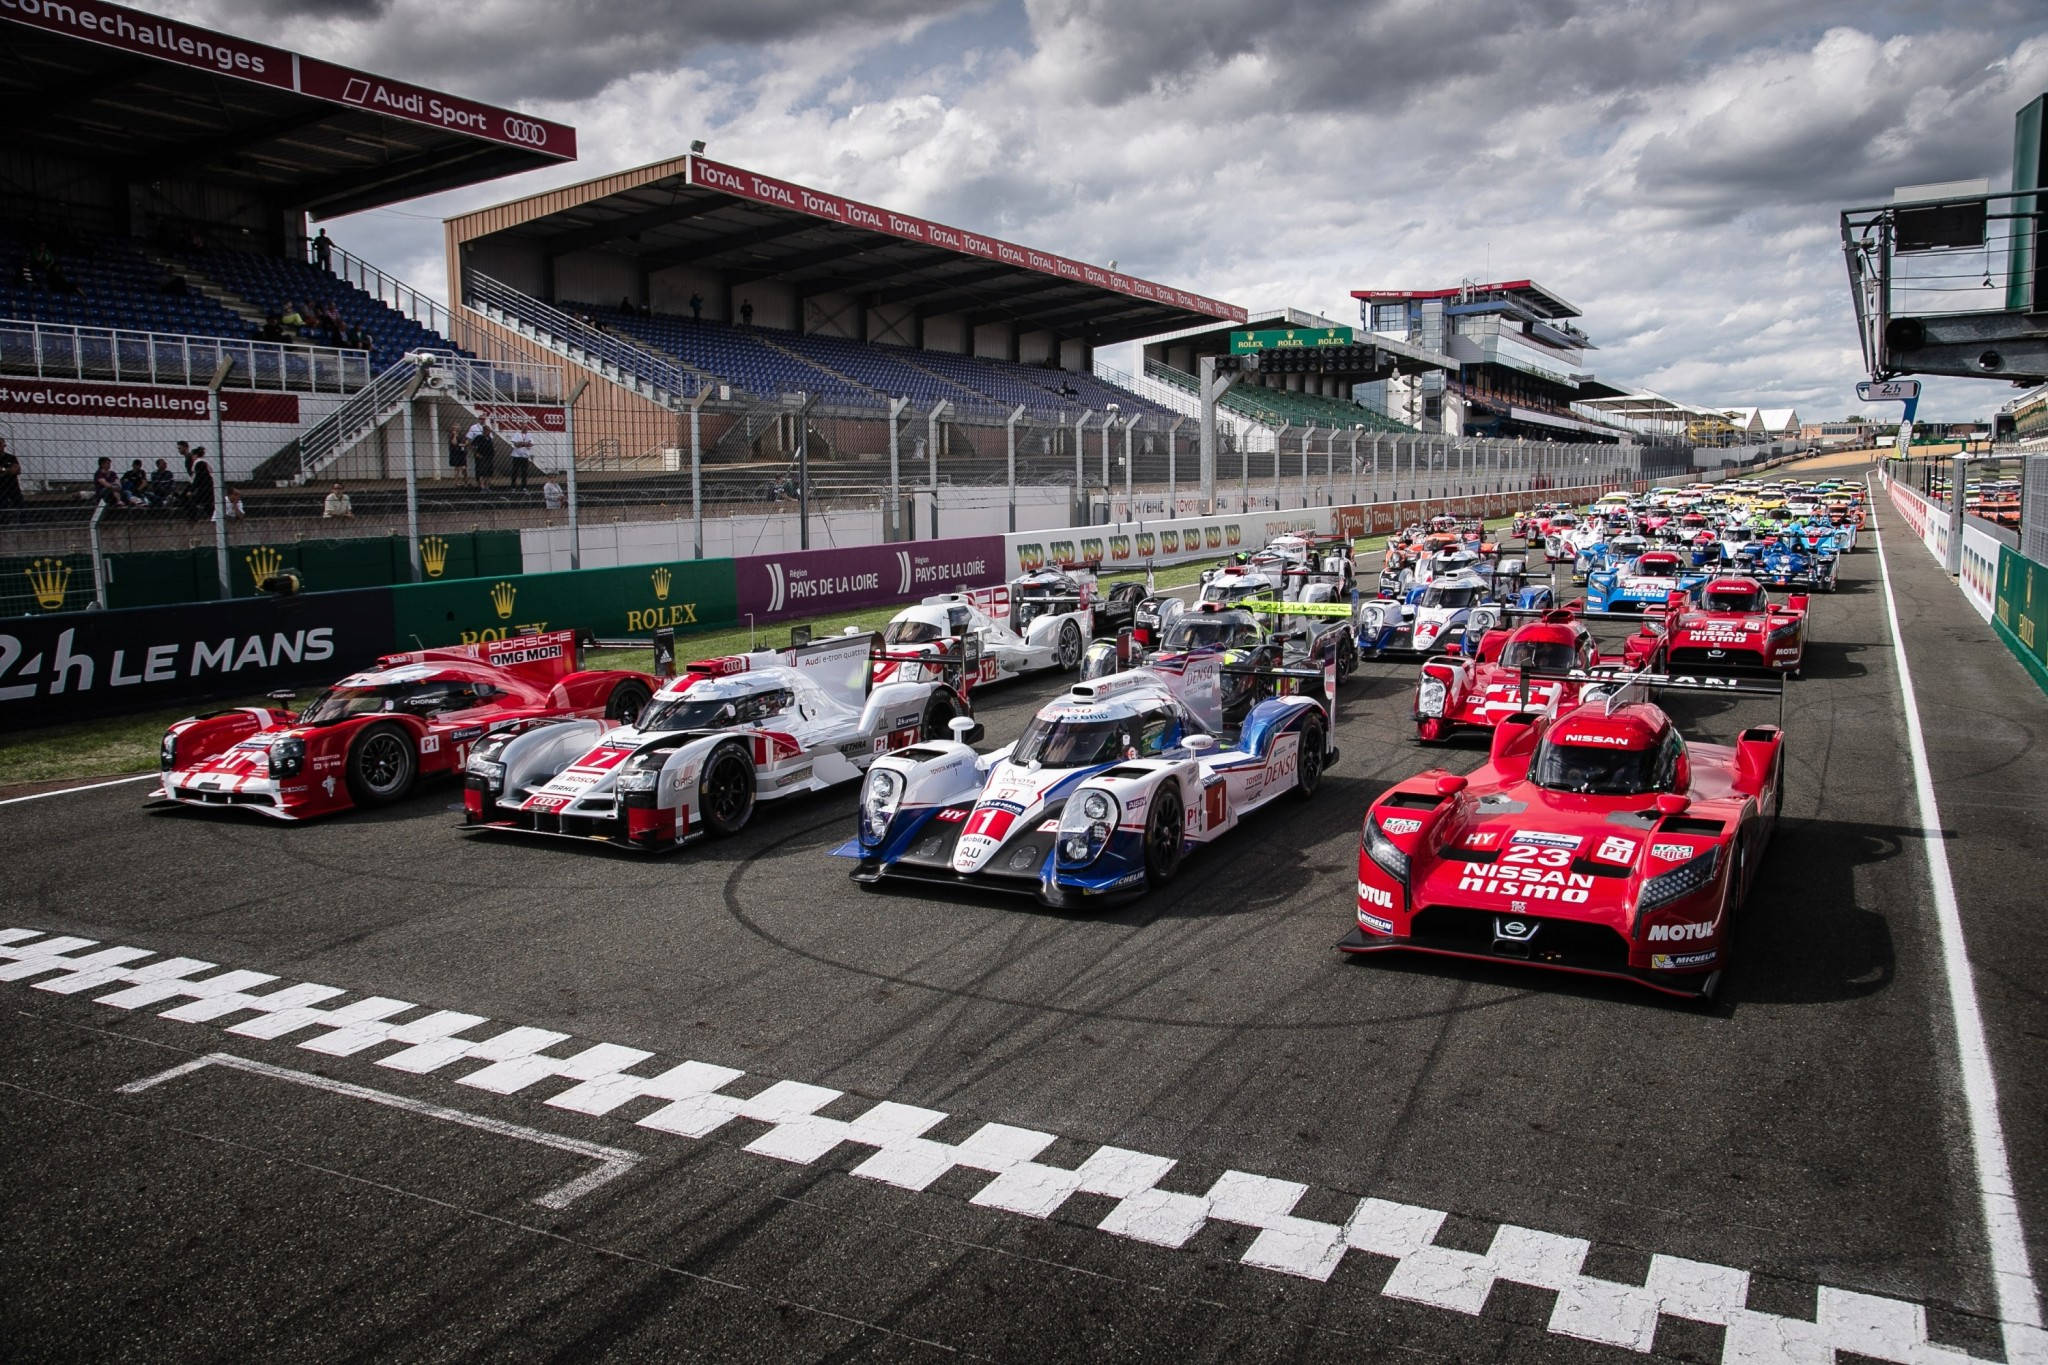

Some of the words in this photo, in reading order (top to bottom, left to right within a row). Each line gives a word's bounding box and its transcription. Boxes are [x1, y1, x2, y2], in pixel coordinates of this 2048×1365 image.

[373, 85, 424, 115] Audi
[430, 99, 487, 130] Sport
[697, 162, 745, 191] TOTAL
[751, 177, 795, 204] TOTAL
[801, 191, 841, 217] TOTAL
[845, 203, 883, 226] TOTAL
[888, 214, 923, 237] TOTAL
[928, 225, 960, 247] TOTAL
[963, 235, 992, 254] TOTAL
[997, 244, 1024, 263] TOTAL
[1027, 252, 1053, 270] TOTAL
[1340, 511, 1364, 530] TOTAL
[1372, 509, 1393, 526] TOTAL
[789, 569, 808, 578] Région
[915, 567, 937, 583] PAYS
[938, 565, 949, 580] DE
[951, 564, 961, 579] LA
[963, 560, 985, 577] LOIRE
[789, 580, 817, 599] PAYS
[819, 578, 833, 595] DE
[836, 576, 849, 593] LA
[851, 572, 878, 592] LOIRE
[627, 603, 698, 633] ROLEX
[461, 622, 548, 645] ROLX
[1421, 624, 1433, 636] 2
[488, 631, 572, 653] PORSCHE
[110, 643, 179, 687] LE
[190, 626, 335, 676] MANS
[527, 646, 562, 663] MORI
[805, 655, 822, 667] Audi
[822, 651, 843, 663] e-tron
[1186, 665, 1213, 687] DENSO
[1062, 713, 1109, 721] HYBRID
[424, 738, 437, 750] P1
[876, 738, 887, 751] P1
[904, 730, 915, 746] 7
[1565, 734, 1629, 746] NISSAN
[588, 751, 619, 767] 7
[1264, 752, 1297, 786] DENSO
[567, 776, 600, 784] BOSCH
[673, 775, 694, 788] ORIS
[1246, 773, 1263, 785] TOYOTA
[548, 784, 579, 792] MAHLE
[1217, 789, 1223, 820] 1
[939, 810, 966, 820] HY
[977, 811, 992, 832] 1
[1187, 809, 1197, 826] P1
[1465, 832, 1497, 845] HY
[1503, 845, 1571, 867] 23
[1603, 846, 1627, 859] P1
[1463, 862, 1596, 888] NISSAN
[1361, 912, 1392, 930] MICHELIN
[1648, 920, 1714, 941] MOTUL
[1676, 951, 1717, 964] MICHELIN
